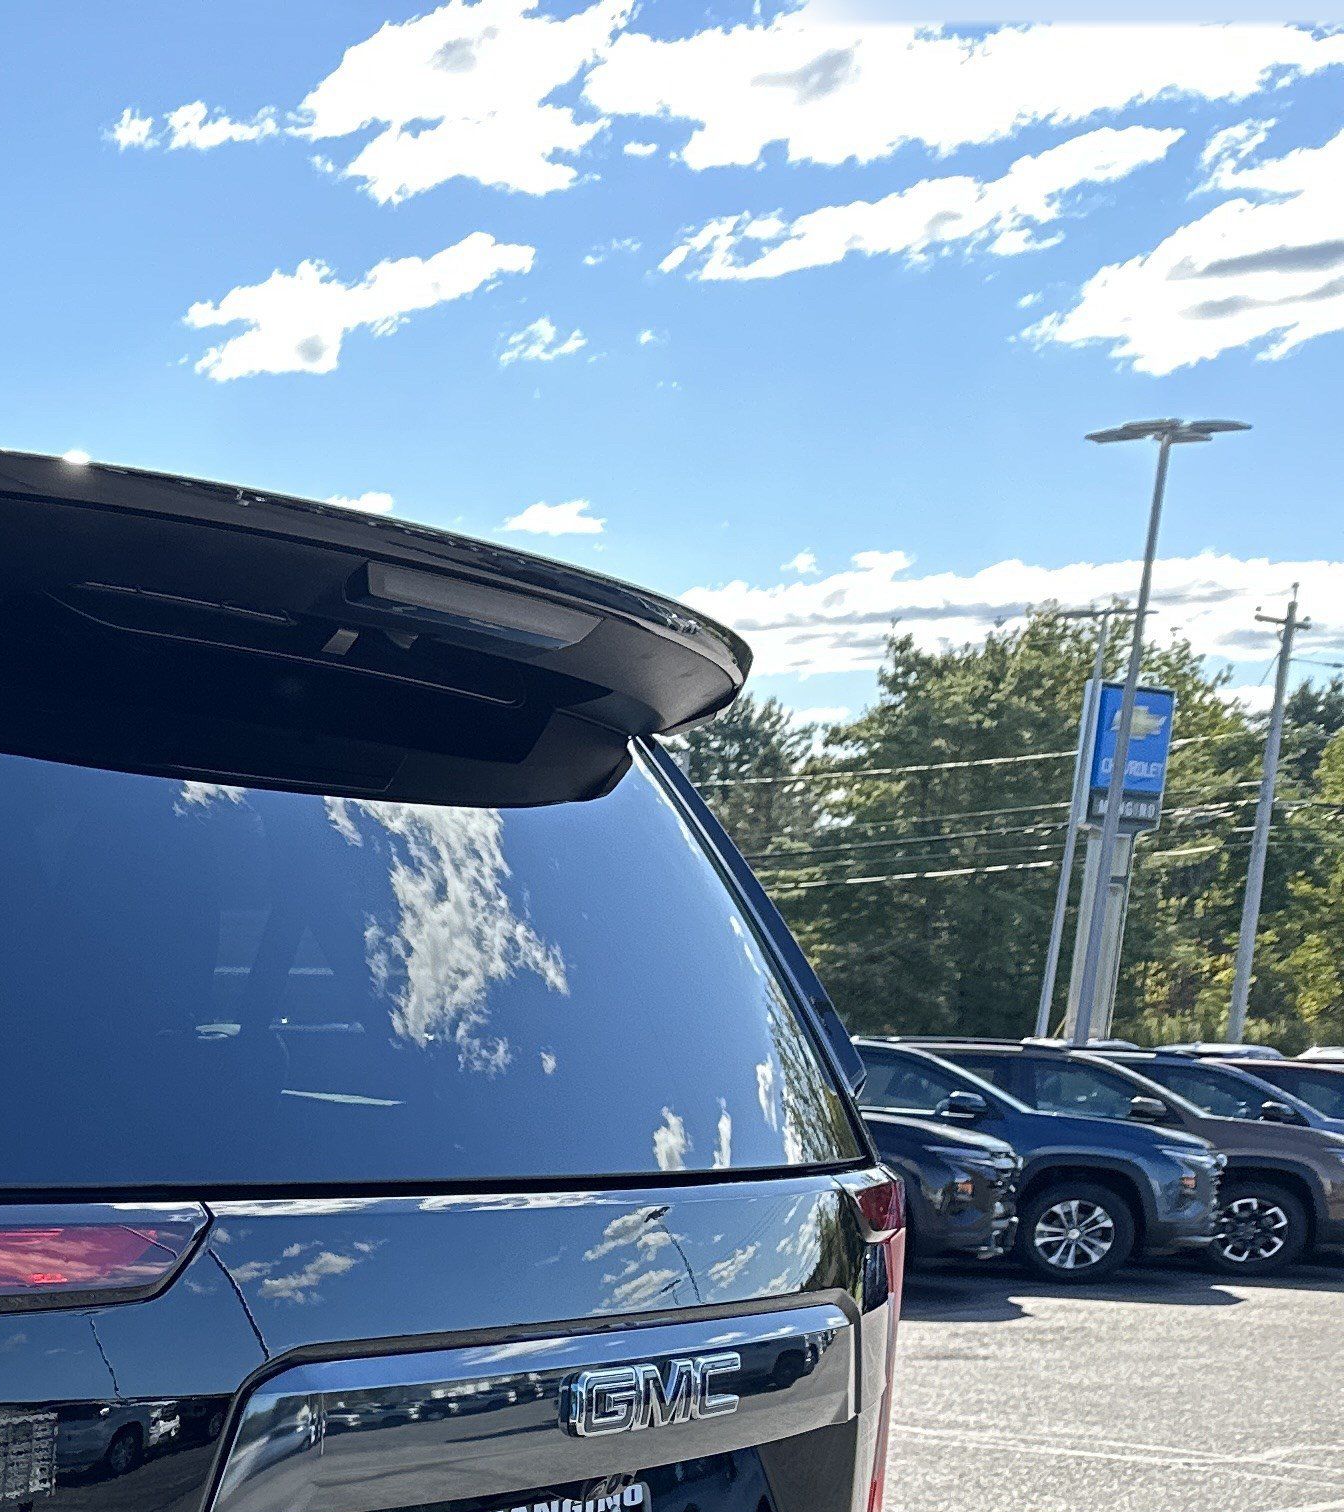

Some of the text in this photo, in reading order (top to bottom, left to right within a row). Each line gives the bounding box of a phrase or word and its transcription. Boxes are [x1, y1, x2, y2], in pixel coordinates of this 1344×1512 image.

[1100, 757, 1164, 778] CVROLET
[1098, 799, 1155, 819] MNGINO
[560, 1350, 742, 1438] GMC
